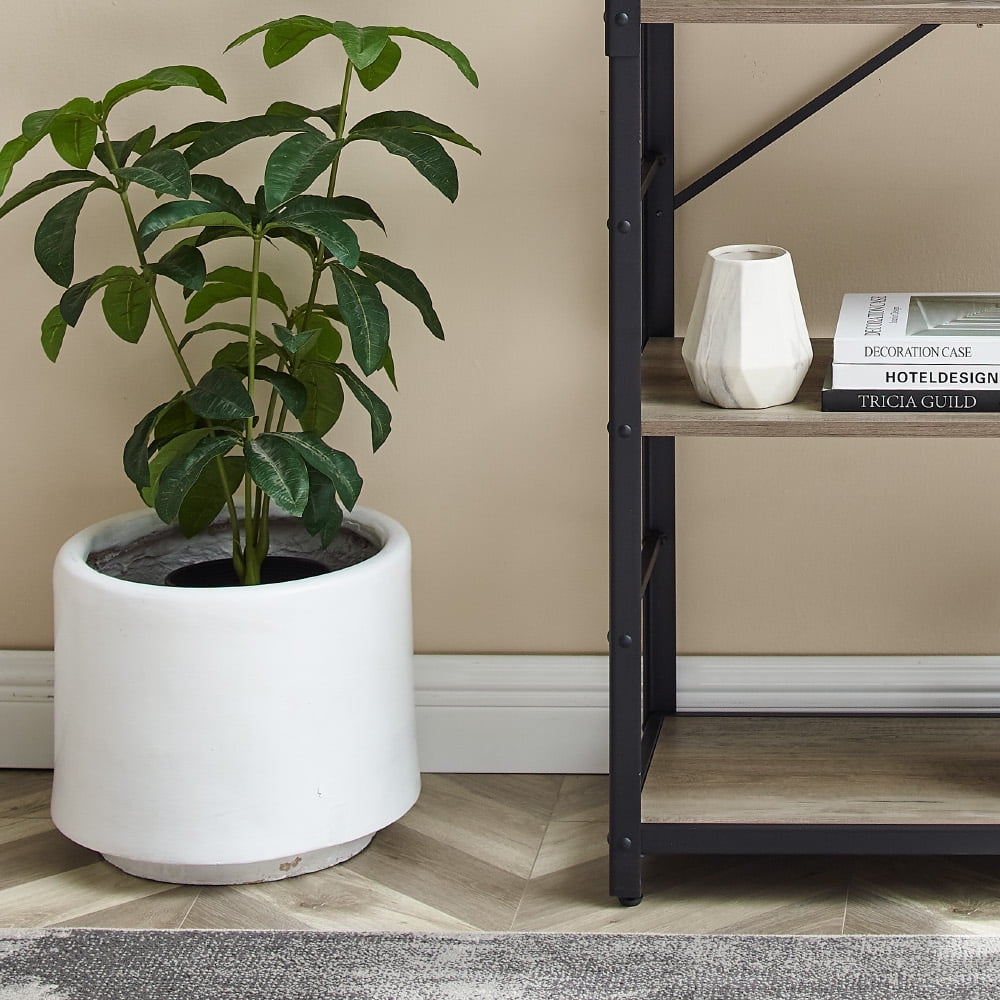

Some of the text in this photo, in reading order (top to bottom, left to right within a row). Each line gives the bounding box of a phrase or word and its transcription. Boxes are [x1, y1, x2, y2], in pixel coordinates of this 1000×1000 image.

[864, 346, 972, 358] DECORATION CASE
[858, 395, 977, 409] TRICIA GUILD
